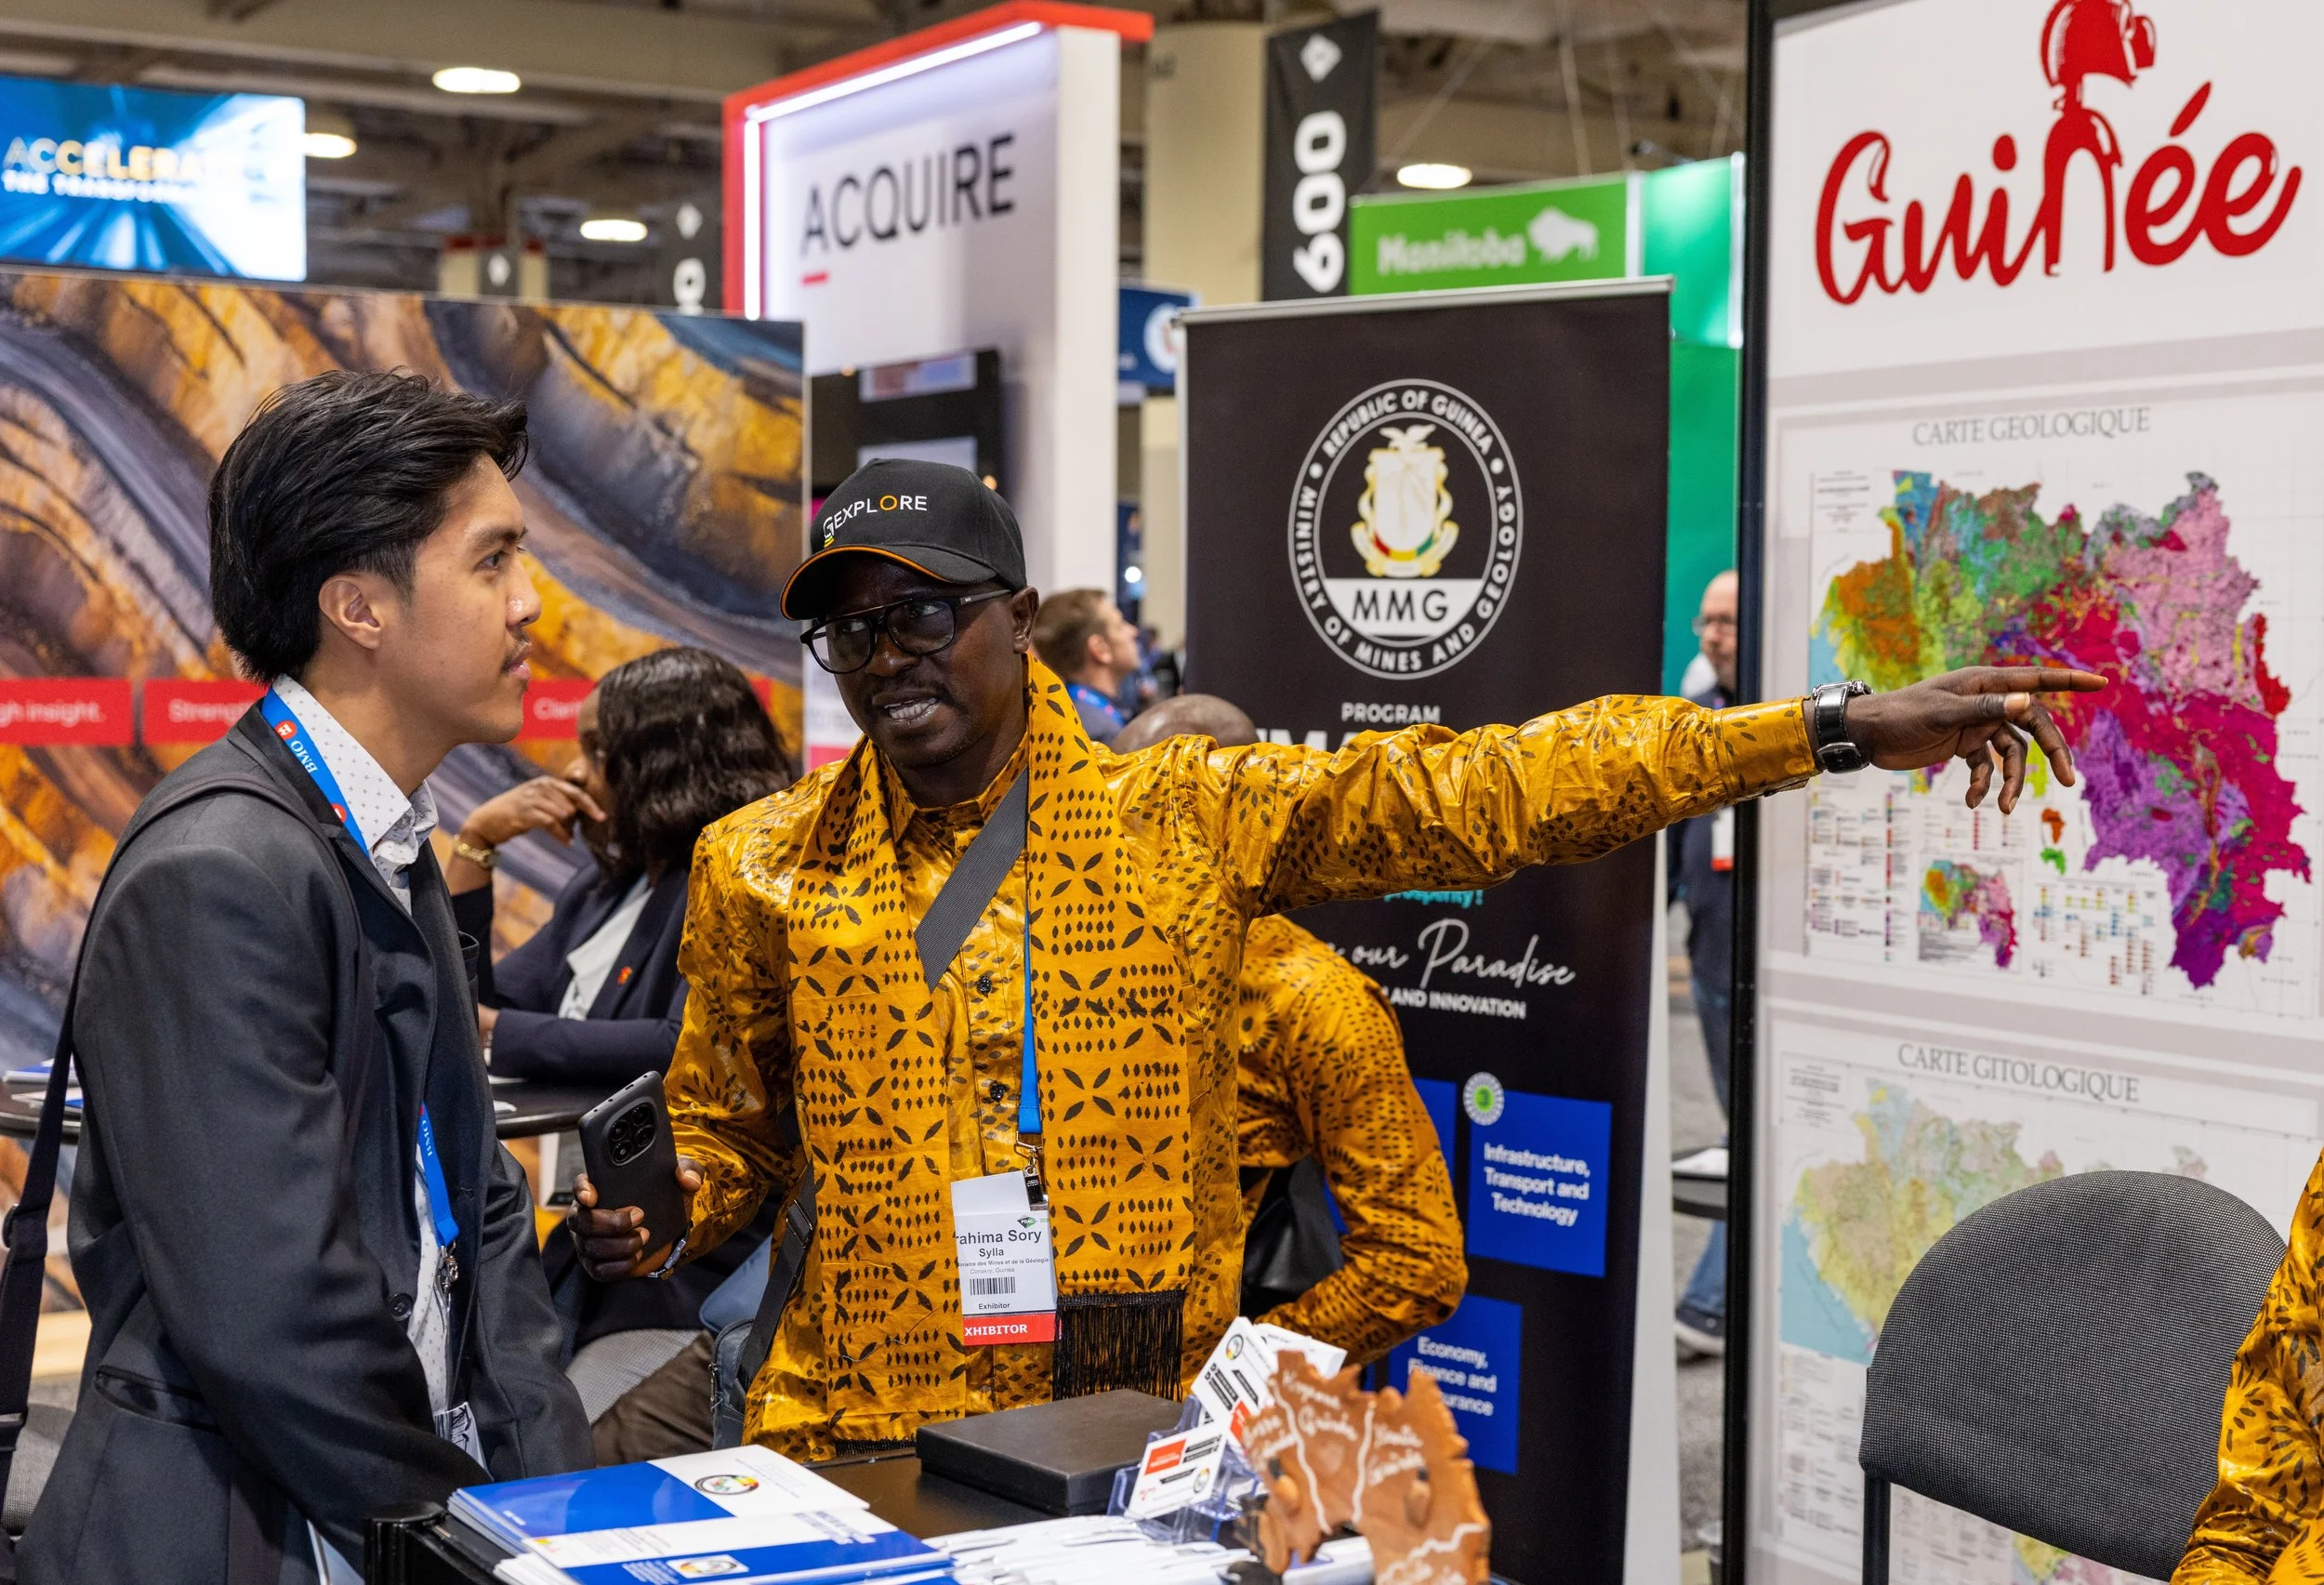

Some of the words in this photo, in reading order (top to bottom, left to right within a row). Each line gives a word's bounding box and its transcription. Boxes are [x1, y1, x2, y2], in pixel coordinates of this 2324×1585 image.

[799, 134, 1016, 257] ACQUIRE
[1292, 110, 1348, 294] 600
[1815, 80, 2304, 306] Guinée
[1378, 229, 1526, 275] Manitoba
[1321, 391, 1398, 459] REPUBLIC
[1401, 389, 1430, 411] OF
[1431, 394, 1494, 456] GUINEA
[1912, 418, 1985, 446] CARTE
[1988, 406, 2152, 442] GEOLOGIQUE
[1296, 485, 1328, 611] MINISTRY
[1324, 615, 1353, 646] OF
[1353, 641, 1423, 672] MINES
[1432, 622, 1476, 666] AND
[1475, 485, 1516, 620] GEOLOGY
[1353, 588, 1448, 623] MMG
[1341, 702, 1441, 724] PROGRAM
[290, 739, 318, 773] BMO
[1351, 944, 1409, 970] our
[1417, 918, 1577, 989] Paradise
[1390, 986, 1428, 1009] AND
[1430, 991, 1527, 1020] INNOVATION
[1897, 1043, 1969, 1076] CARTE
[1973, 1054, 2141, 1103] GITOLOGIQUE
[1484, 1142, 1591, 1178] Infrastructure,
[1484, 1166, 1555, 1195] Transport
[1556, 1182, 1590, 1200] and
[1491, 1192, 1578, 1227] Technology
[957, 1232, 1004, 1245] ahima
[1008, 1229, 1042, 1244] Sory
[979, 1248, 1004, 1259] Sylla
[965, 1324, 1028, 1337] XHIBITOR
[1418, 1336, 1488, 1369] Economy,
[1468, 1373, 1498, 1393] and
[1440, 1393, 1494, 1417] urance
